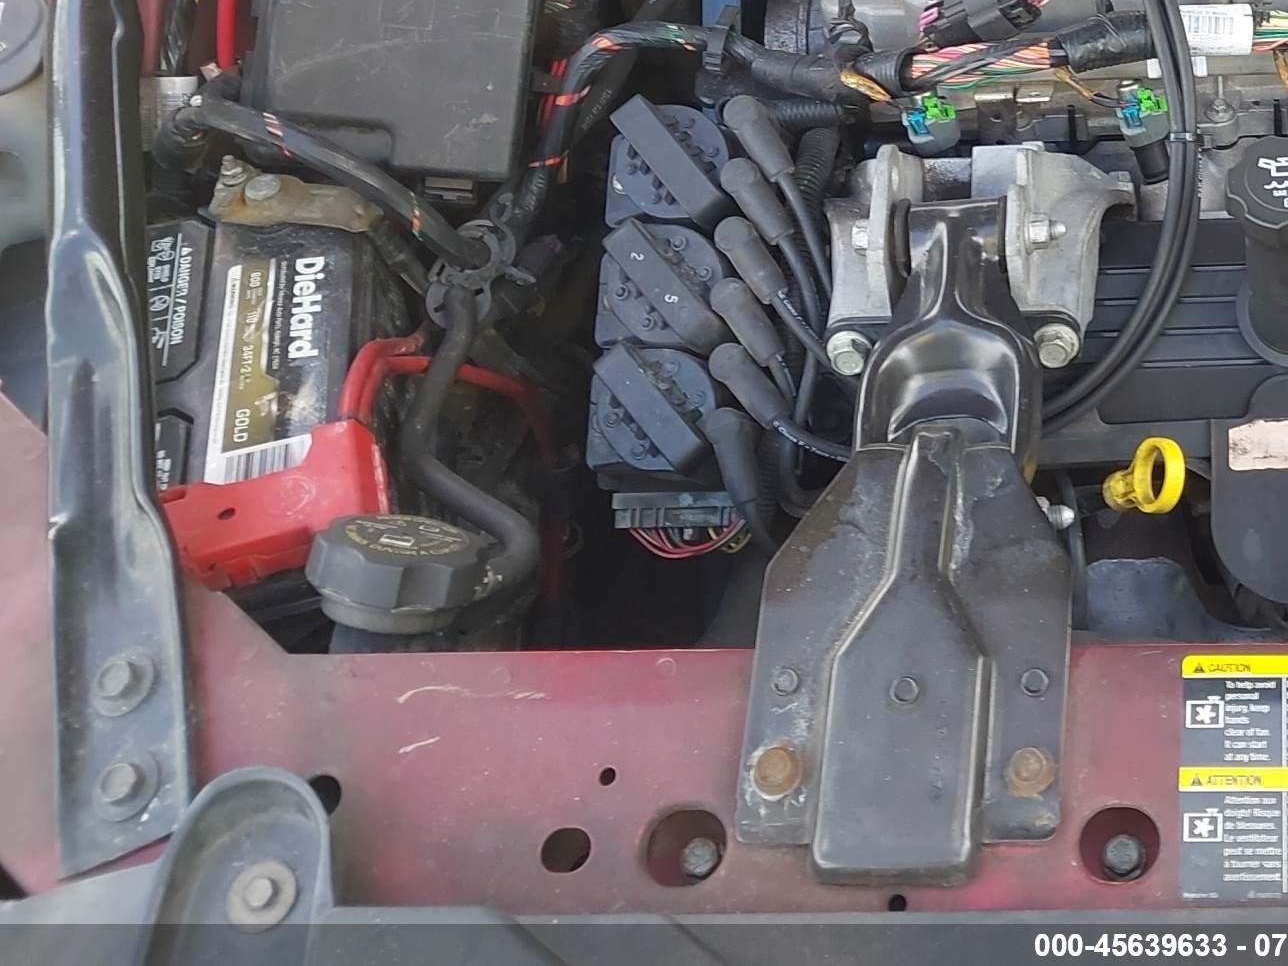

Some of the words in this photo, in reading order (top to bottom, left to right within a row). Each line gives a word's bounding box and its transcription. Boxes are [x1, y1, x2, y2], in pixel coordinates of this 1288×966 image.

[630, 252, 645, 261] 2
[176, 256, 192, 297] DANGER
[288, 256, 325, 359] DieHard
[664, 294, 679, 304] 5
[170, 305, 187, 345] POISON
[233, 409, 251, 443] GOLD
[1206, 775, 1262, 786] ATTENTION
